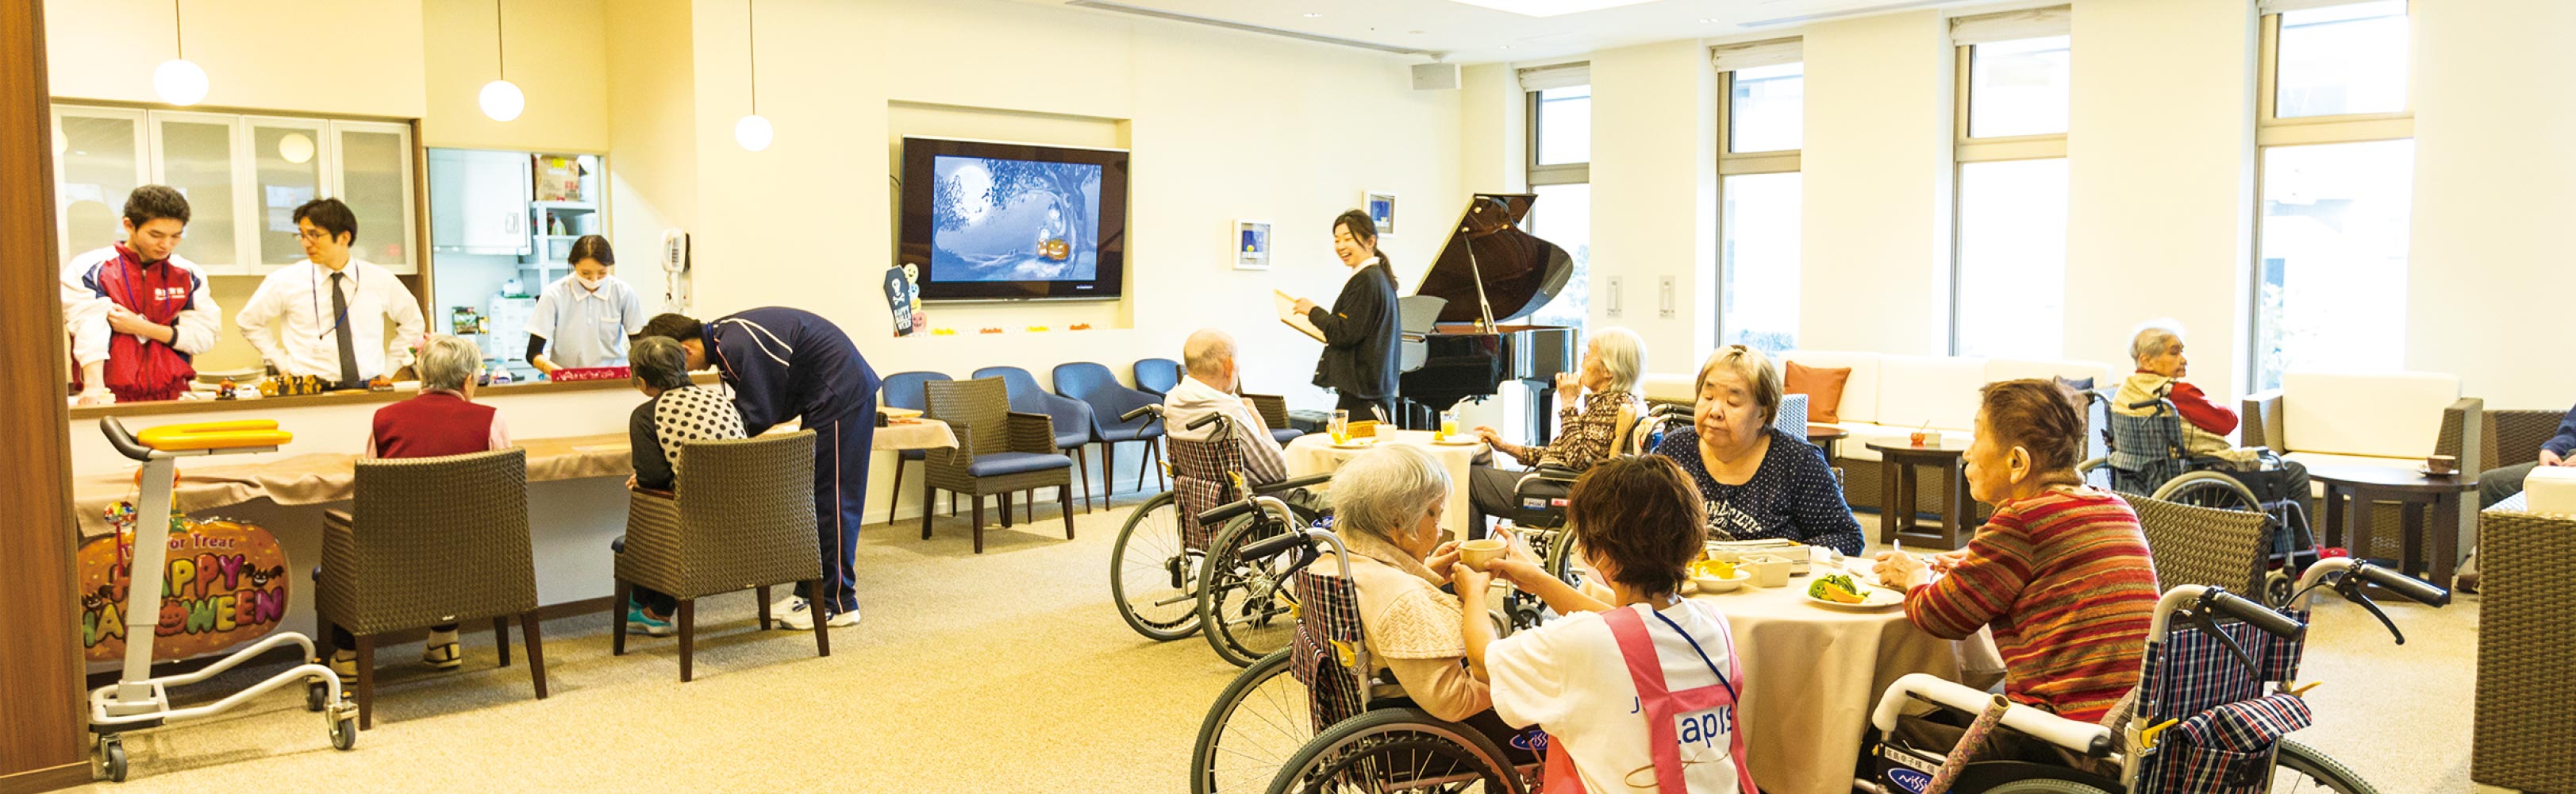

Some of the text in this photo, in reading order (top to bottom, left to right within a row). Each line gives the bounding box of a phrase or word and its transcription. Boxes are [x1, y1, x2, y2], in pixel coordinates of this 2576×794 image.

[170, 533, 236, 549] or Treat
[110, 552, 246, 603] HPPY
